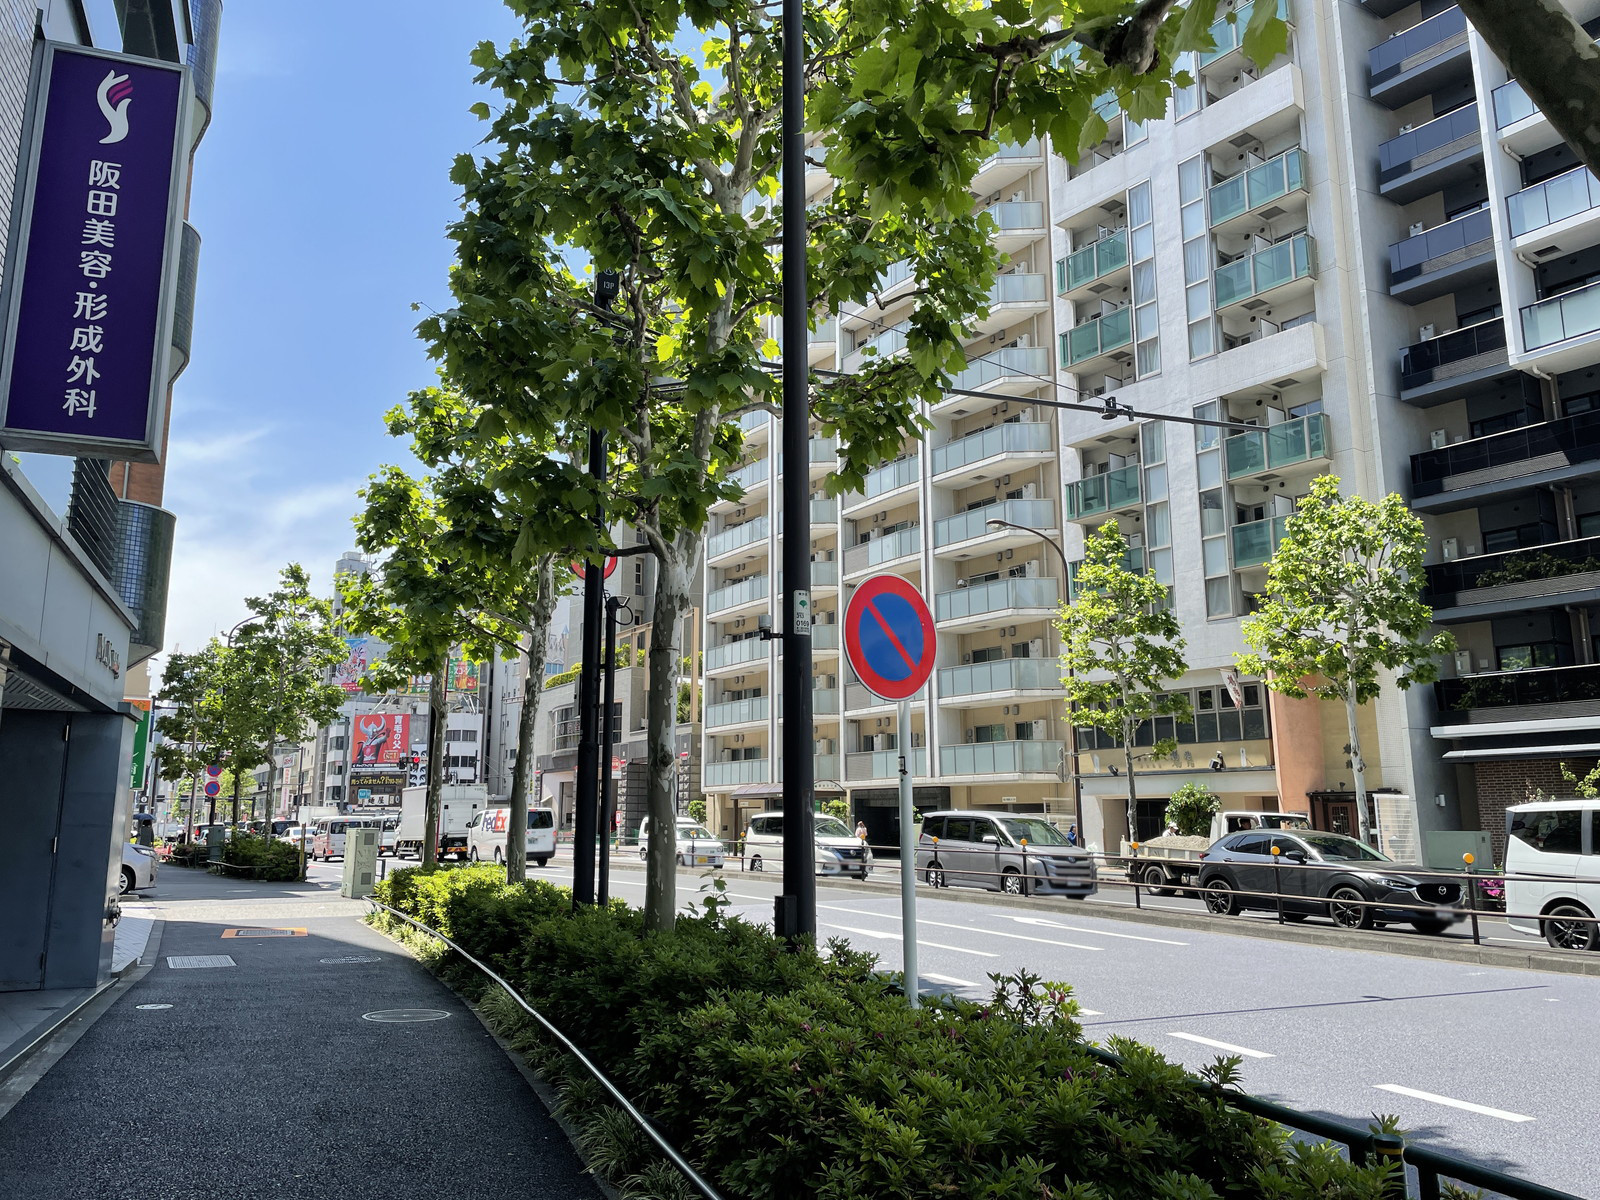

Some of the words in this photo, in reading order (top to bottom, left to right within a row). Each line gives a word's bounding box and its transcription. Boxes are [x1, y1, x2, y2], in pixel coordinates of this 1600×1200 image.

[62, 159, 123, 419] 阪田美容・形成外科
[393, 715, 403, 749] 育毛の父
[482, 809, 507, 832] FedEx
